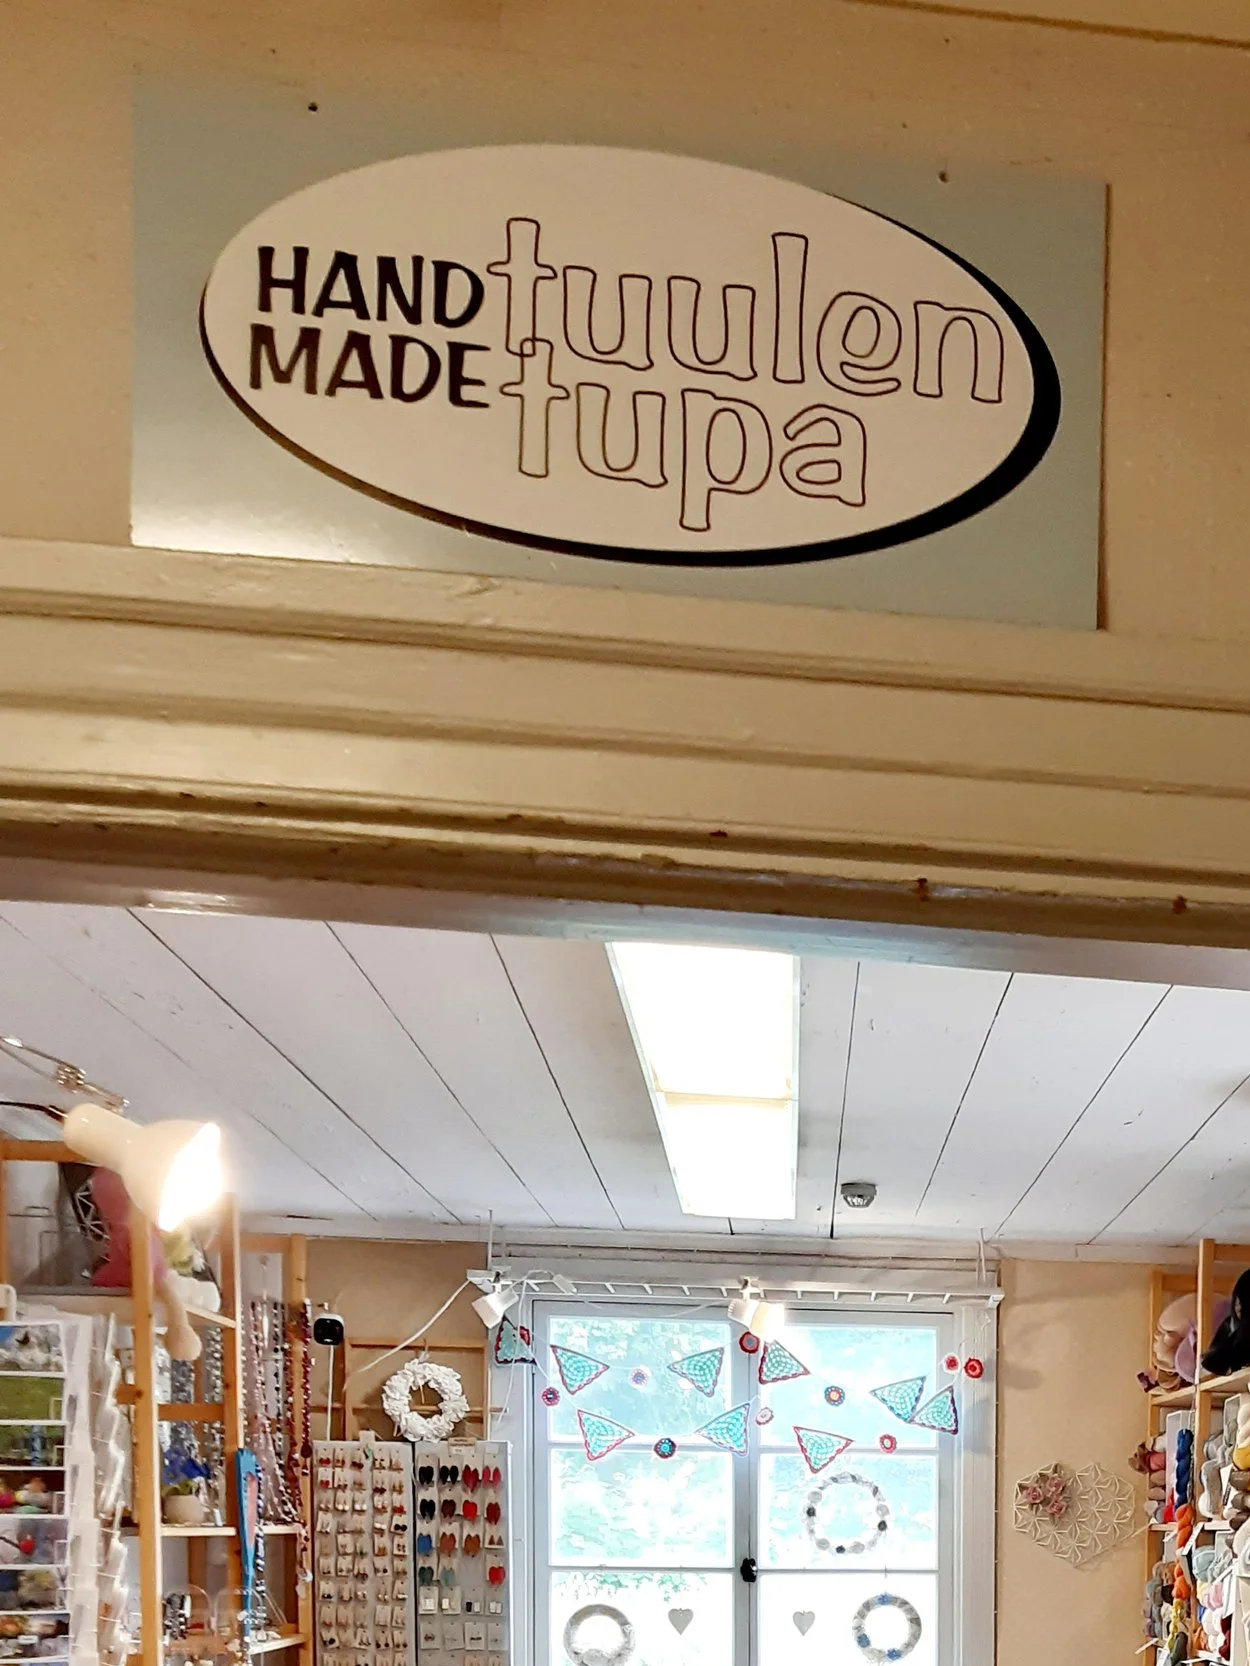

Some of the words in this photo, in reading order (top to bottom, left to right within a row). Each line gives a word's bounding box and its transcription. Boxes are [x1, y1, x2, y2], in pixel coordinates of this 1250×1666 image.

[256, 244, 485, 331] HAND
[486, 216, 1004, 403] tuulen
[248, 323, 491, 408] MADE
[499, 337, 868, 533] tupa
